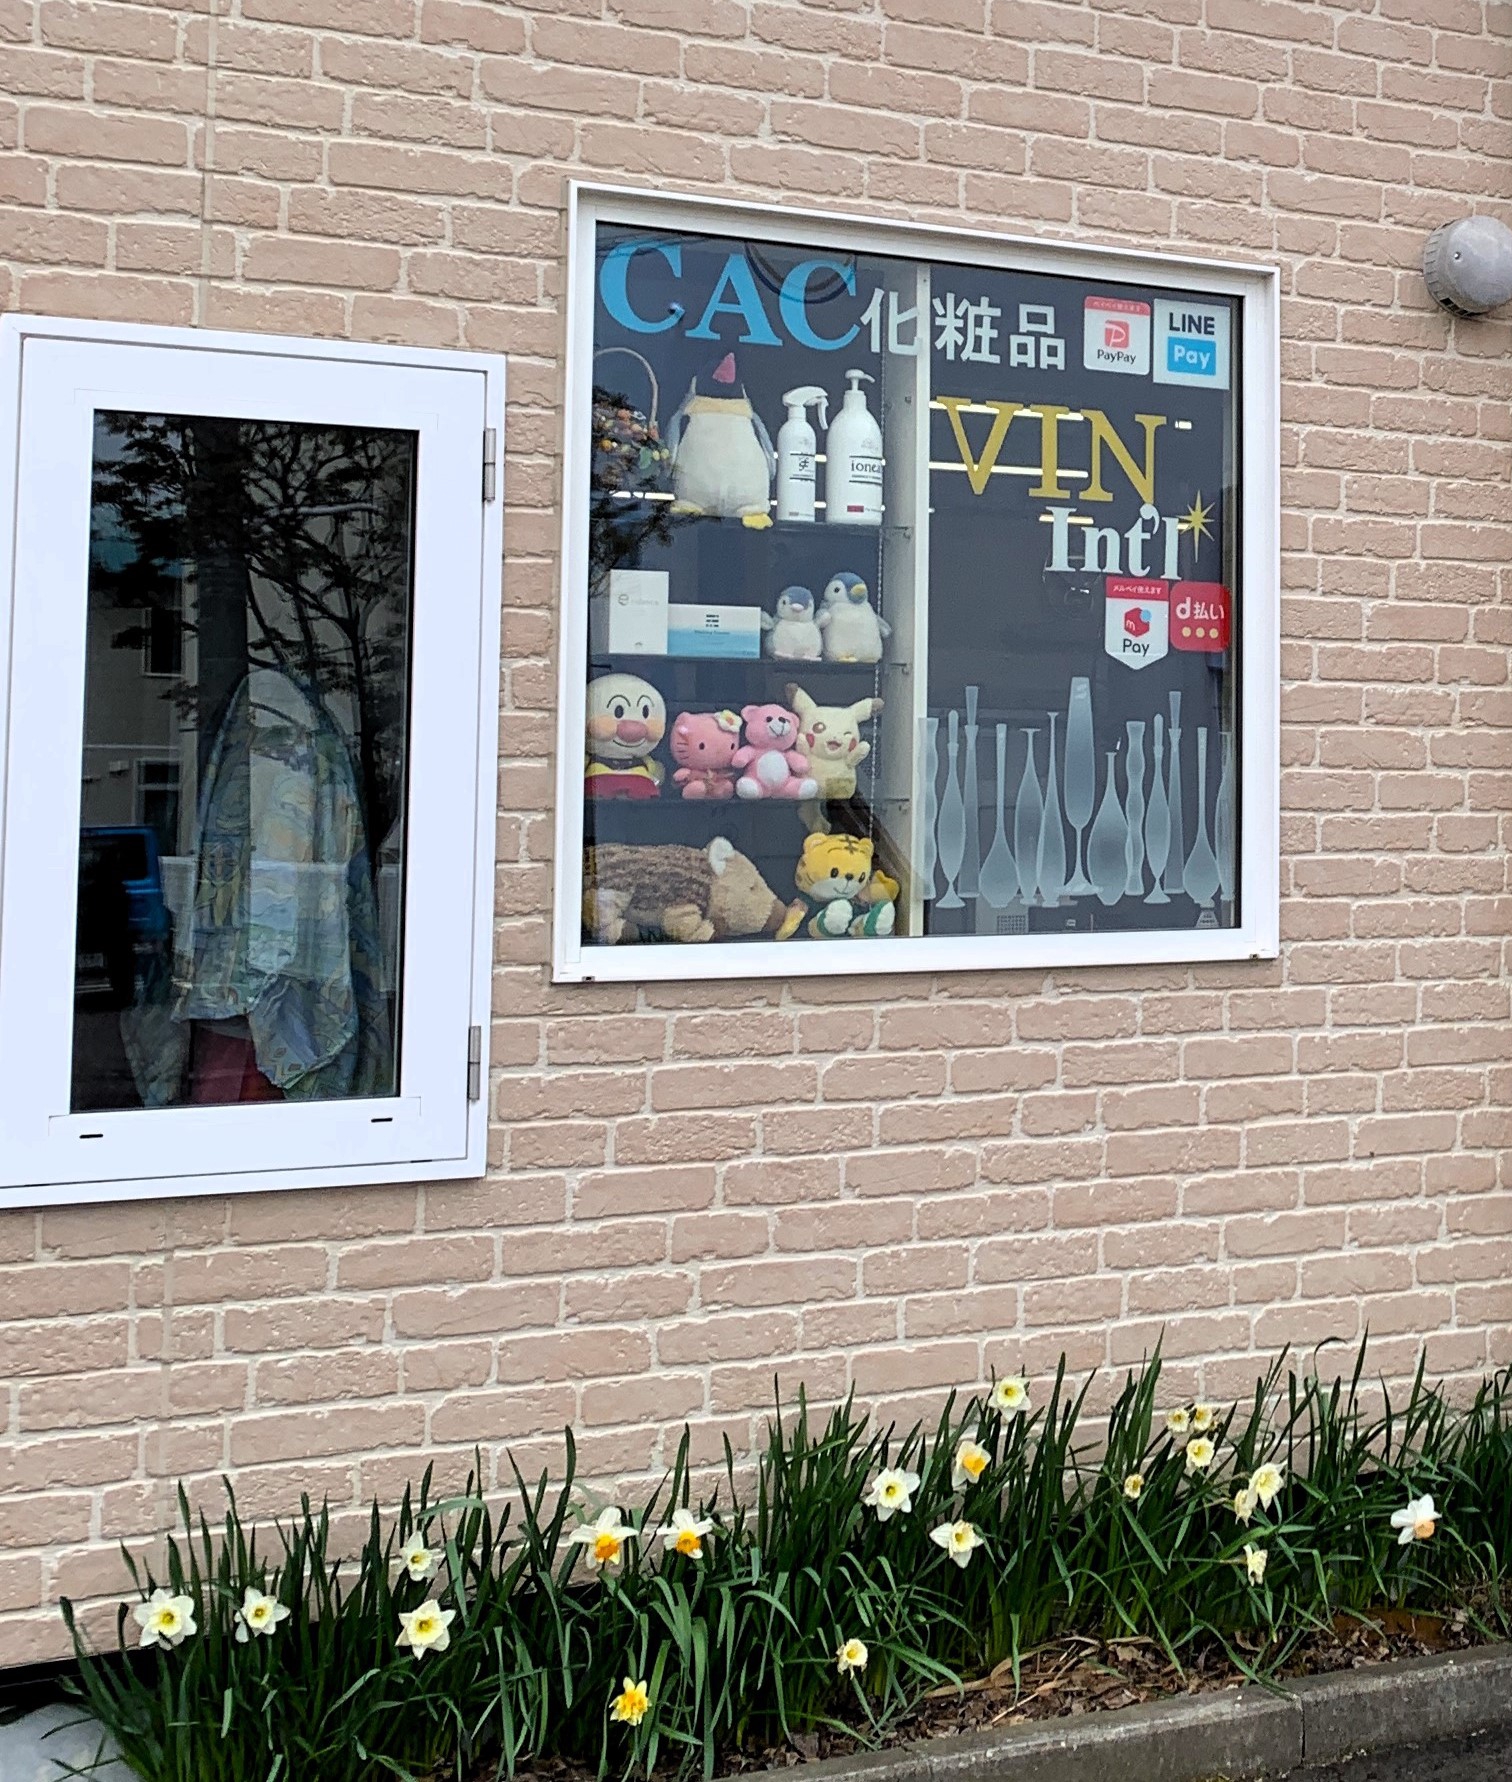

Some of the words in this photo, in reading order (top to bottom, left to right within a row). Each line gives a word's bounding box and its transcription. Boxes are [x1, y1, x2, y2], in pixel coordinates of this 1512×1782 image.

[600, 241, 860, 351] CAC
[860, 287, 1067, 371] 化粧品
[1169, 312, 1215, 336] LINE
[1097, 349, 1136, 365] PayPay
[1174, 345, 1211, 370] Pay
[936, 395, 1168, 505] VIN
[1045, 503, 1182, 580] Int'l
[1112, 584, 1162, 595] メルペイ使えます
[1176, 596, 1225, 620] d払い
[1122, 638, 1150, 657] Pay
